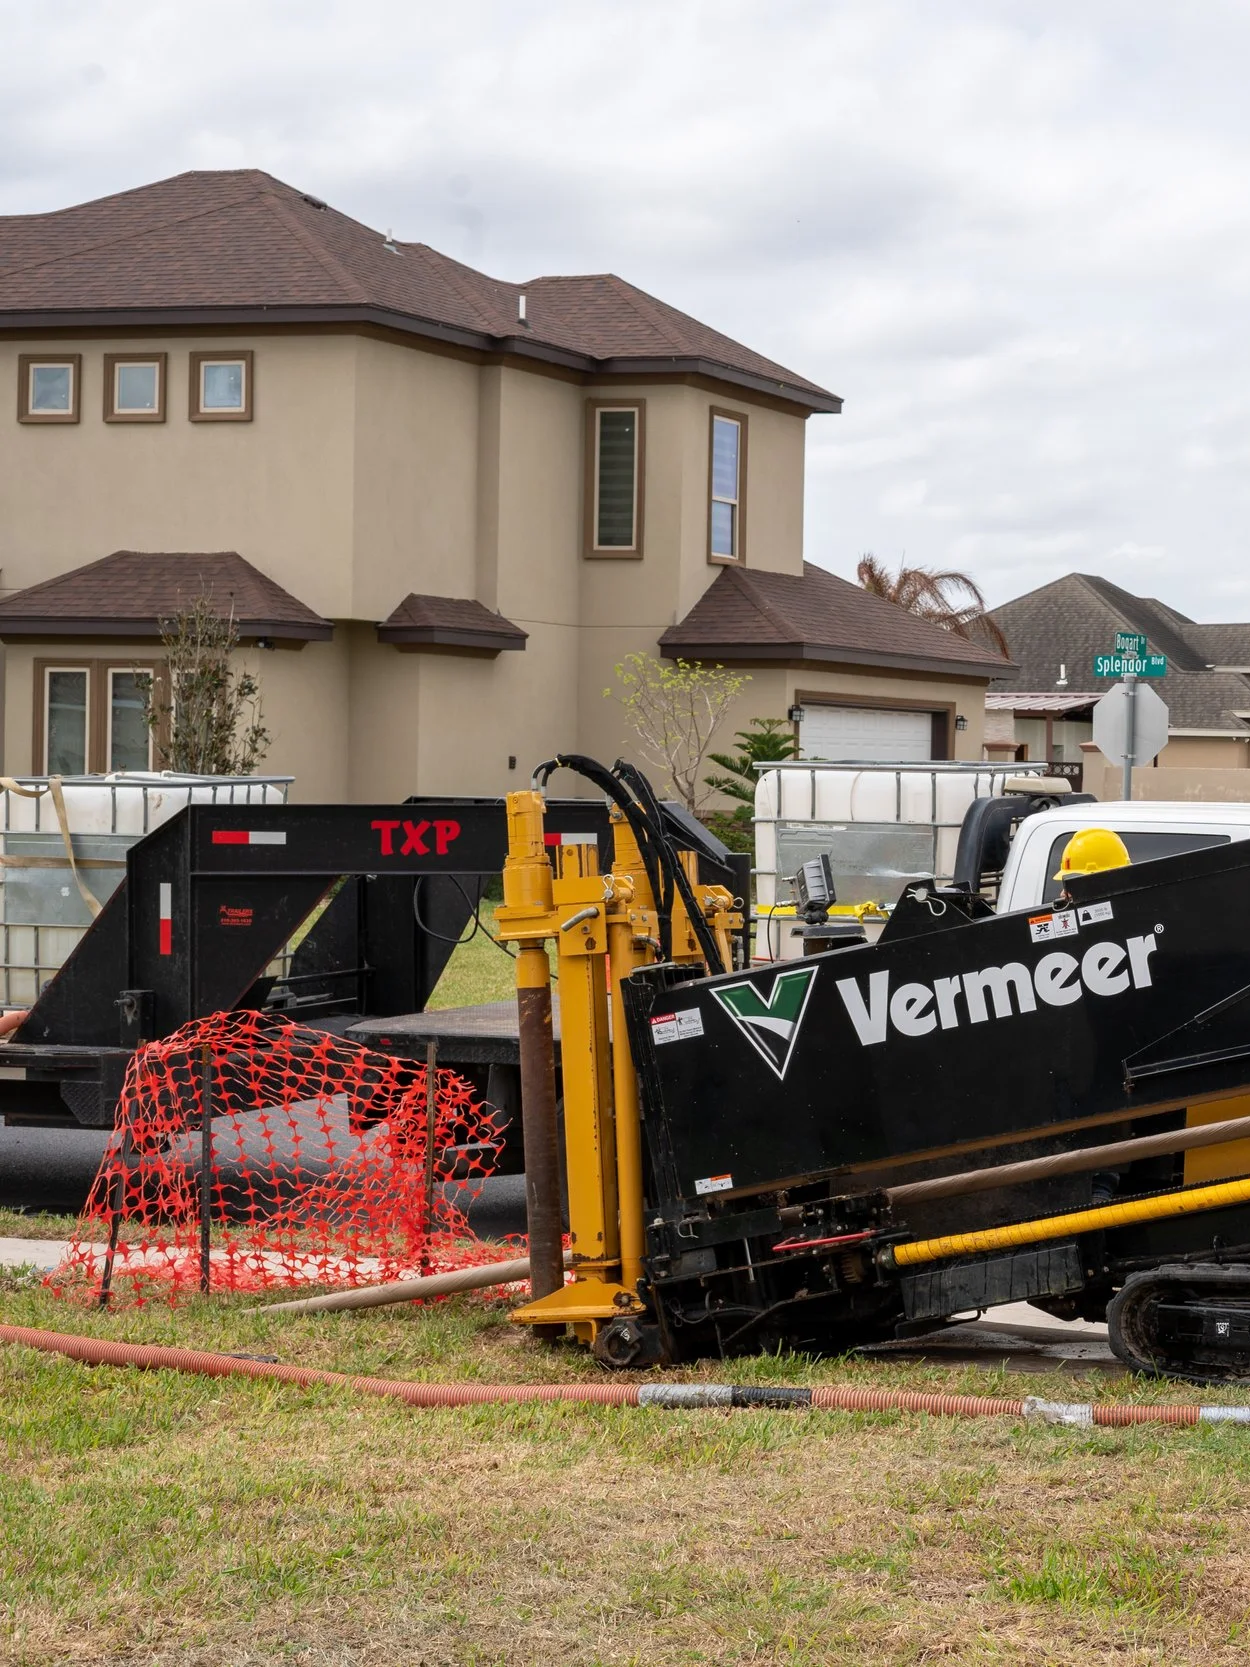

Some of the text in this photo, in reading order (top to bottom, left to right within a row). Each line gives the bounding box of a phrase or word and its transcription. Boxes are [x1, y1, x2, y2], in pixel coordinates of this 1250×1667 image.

[1116, 633, 1139, 651] Bogart
[1097, 656, 1164, 676] Splendor Blvd
[371, 820, 461, 856] TXP
[656, 1013, 675, 1022] DANGER
